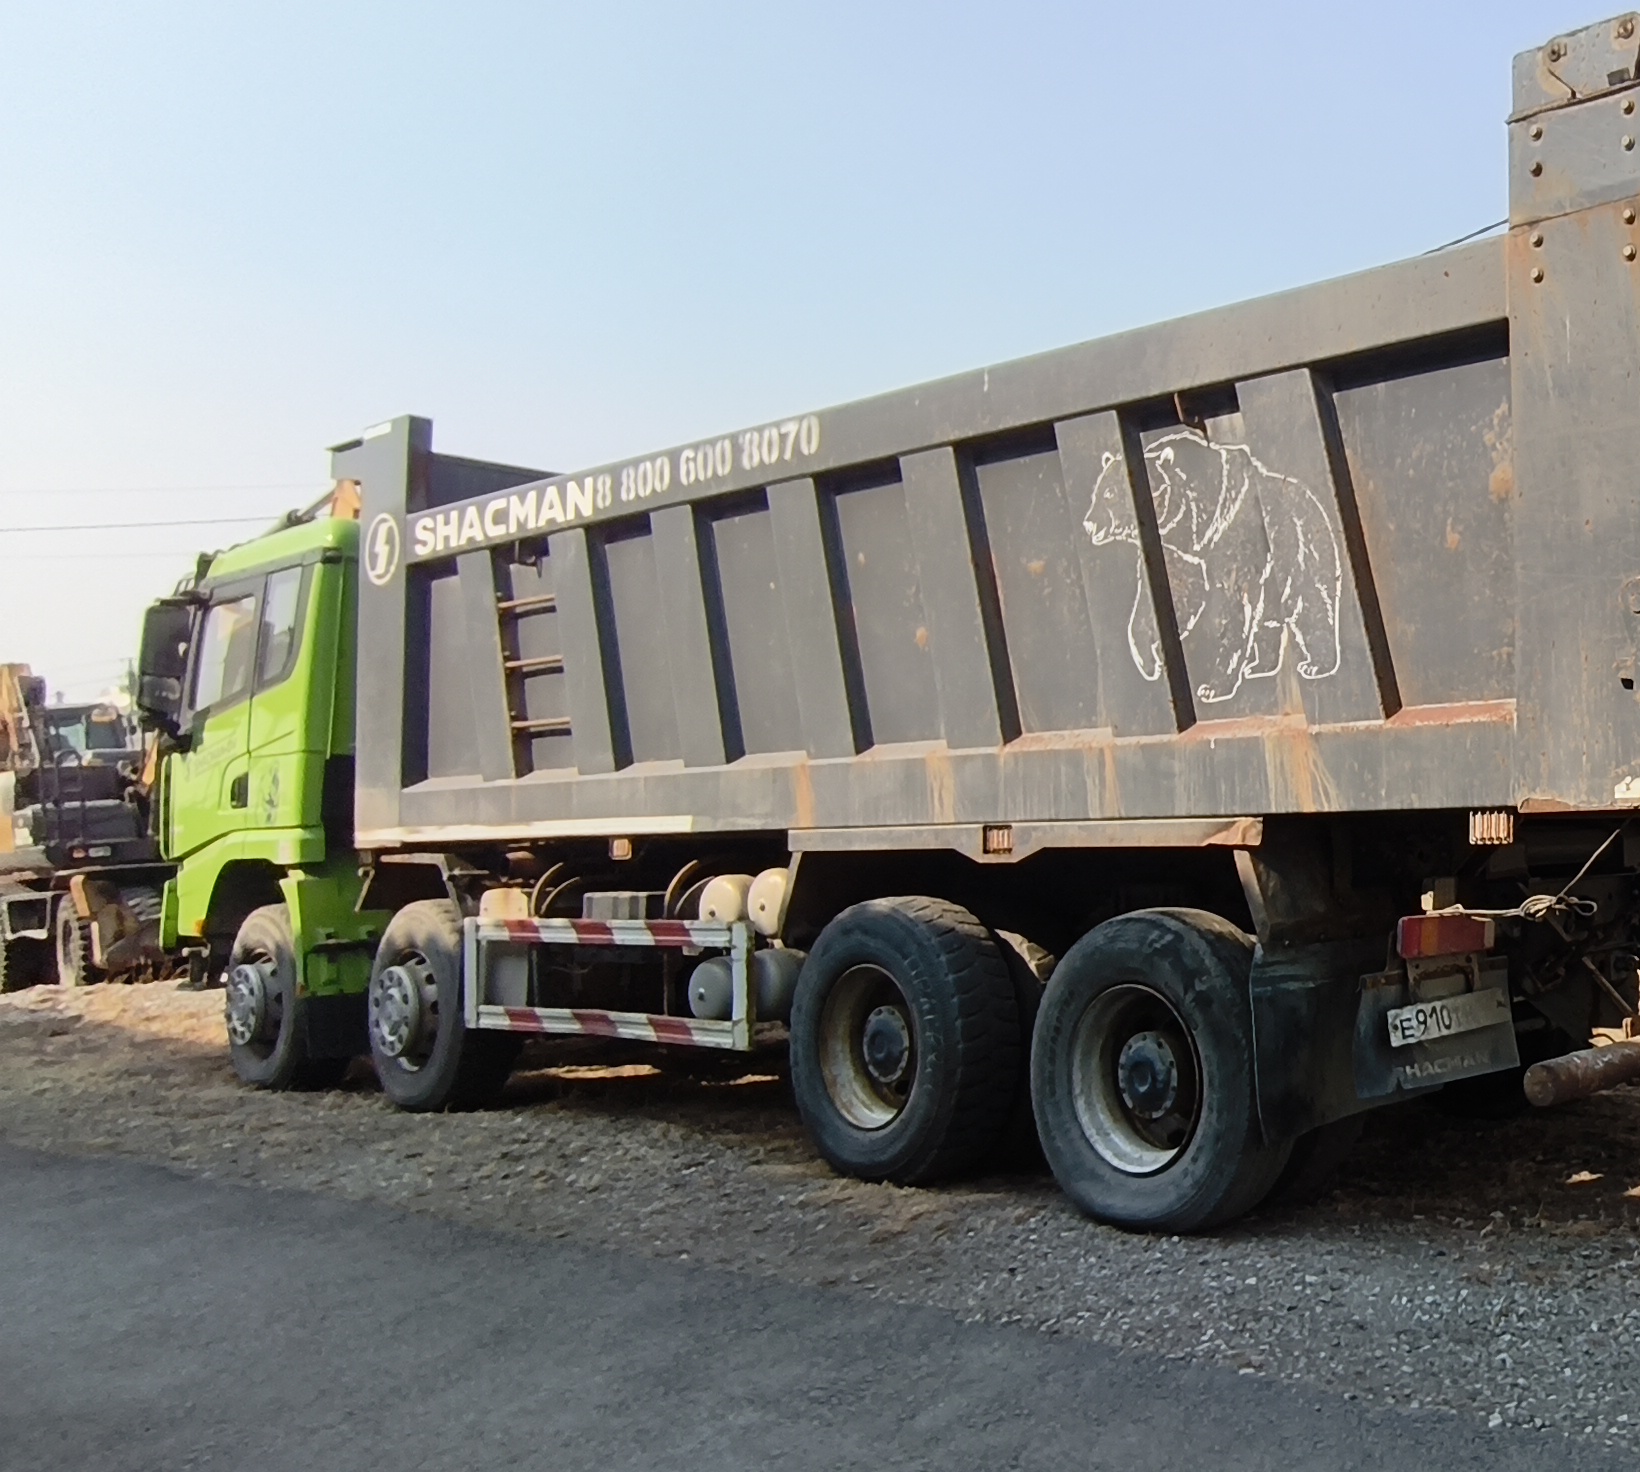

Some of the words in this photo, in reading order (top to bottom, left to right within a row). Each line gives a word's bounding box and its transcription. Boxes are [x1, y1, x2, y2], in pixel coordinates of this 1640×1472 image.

[414, 476, 593, 556] SHACMAN
[596, 473, 612, 509] 8
[620, 455, 671, 503] 800
[679, 438, 732, 486] 600
[741, 414, 820, 471] 8070
